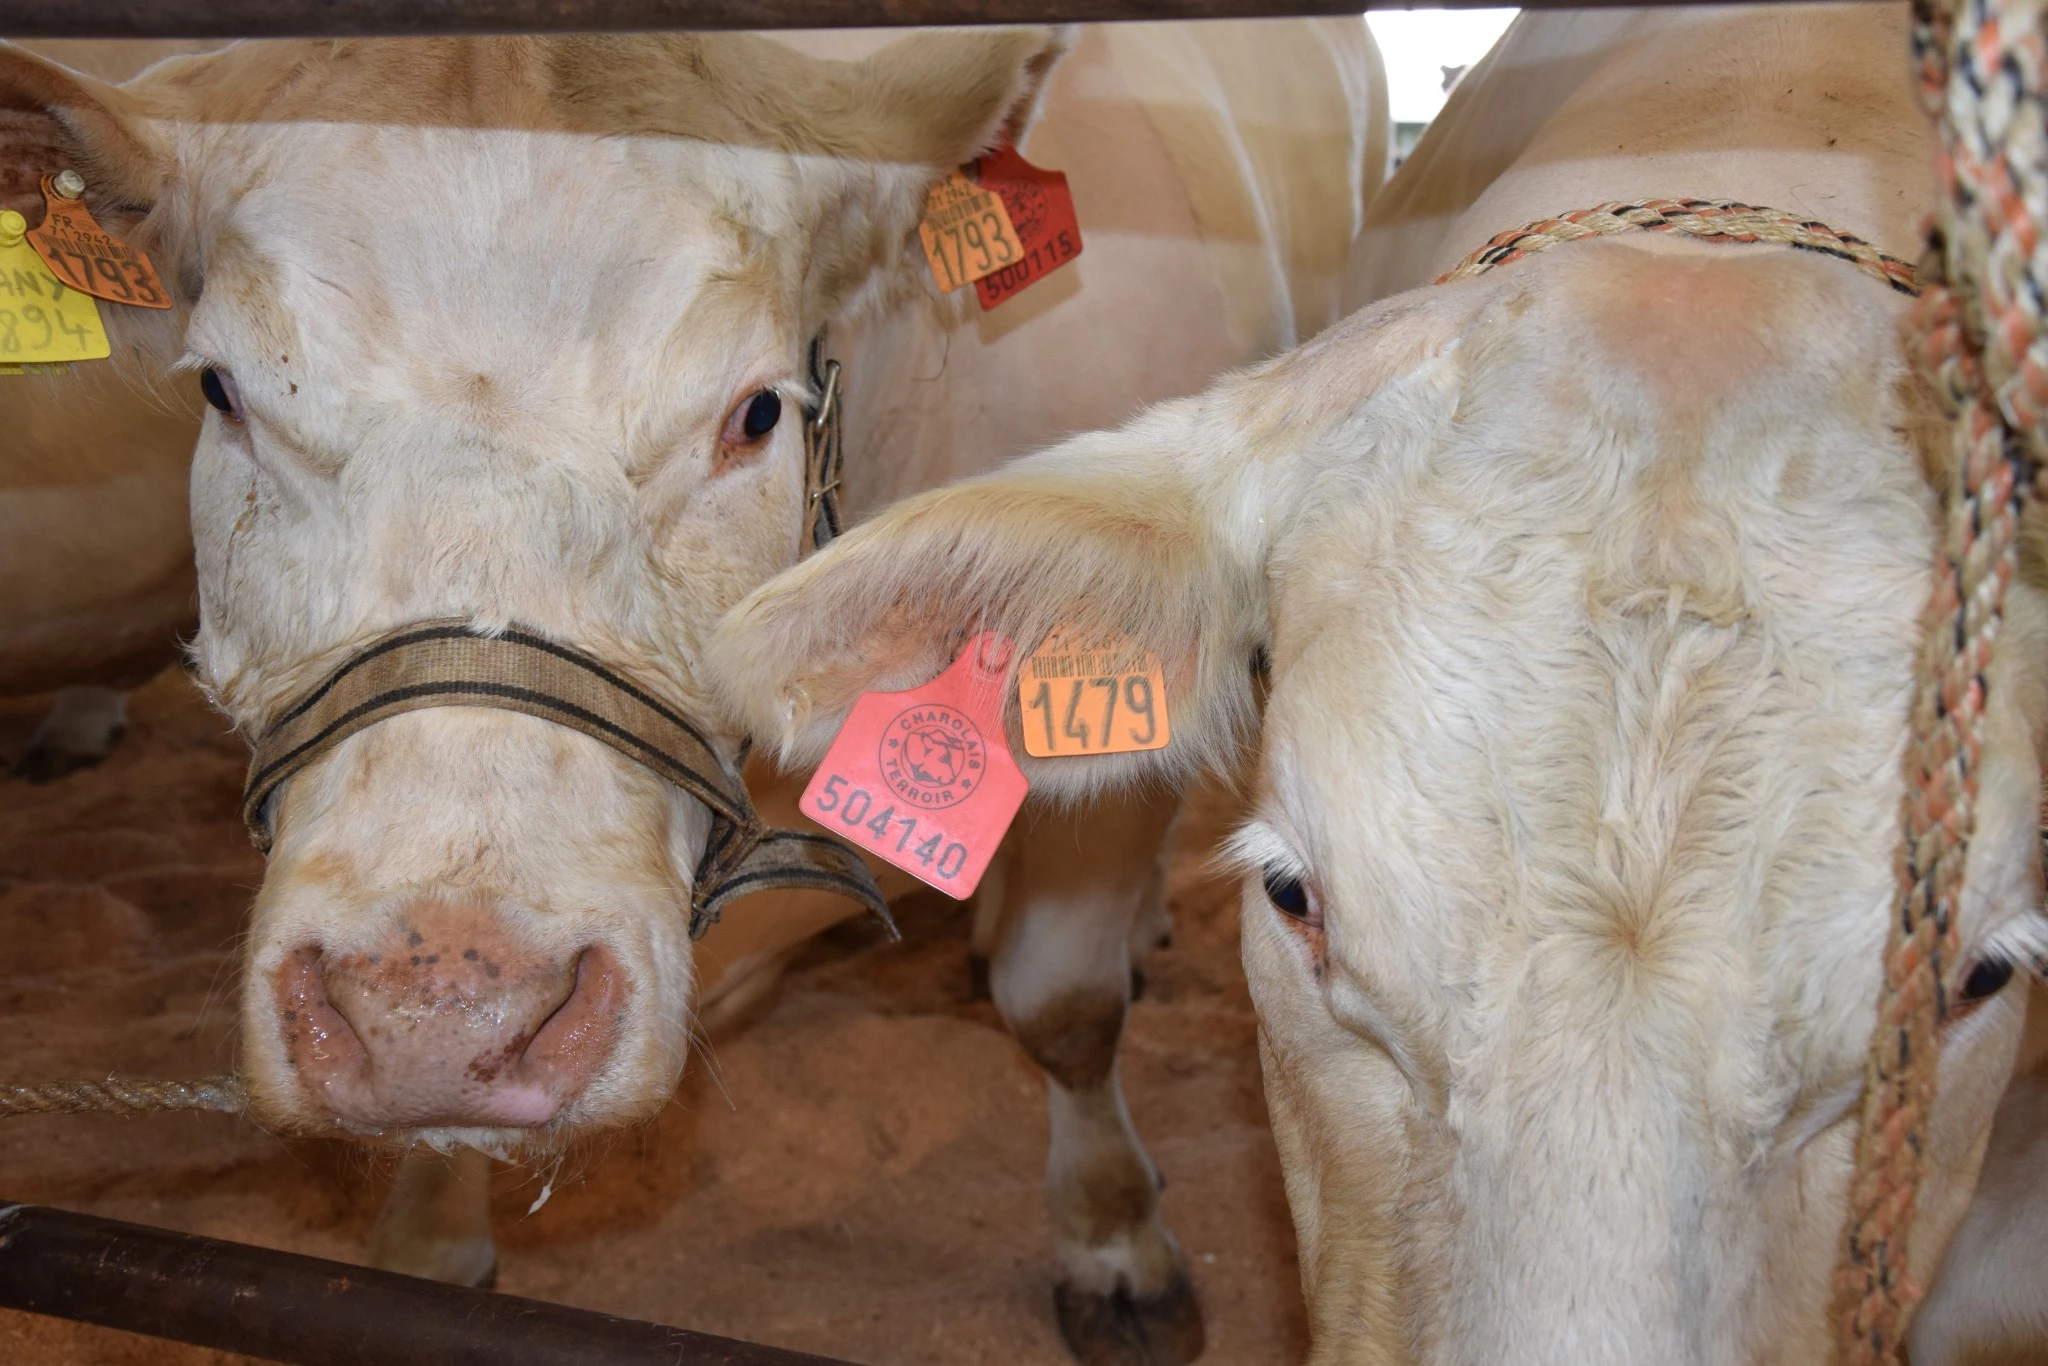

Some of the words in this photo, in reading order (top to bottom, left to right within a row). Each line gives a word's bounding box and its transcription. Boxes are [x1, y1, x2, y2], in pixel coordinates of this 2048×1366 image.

[52, 214, 74, 229] FR
[73, 230, 114, 246] 2942
[933, 211, 1013, 286] 1793
[47, 250, 160, 303] 1793
[984, 230, 1074, 300] 500115
[899, 711, 982, 771] CHAROLAIS
[1029, 674, 1157, 752] 1479
[885, 757, 955, 805] TERROIR
[815, 774, 969, 880] 504140
